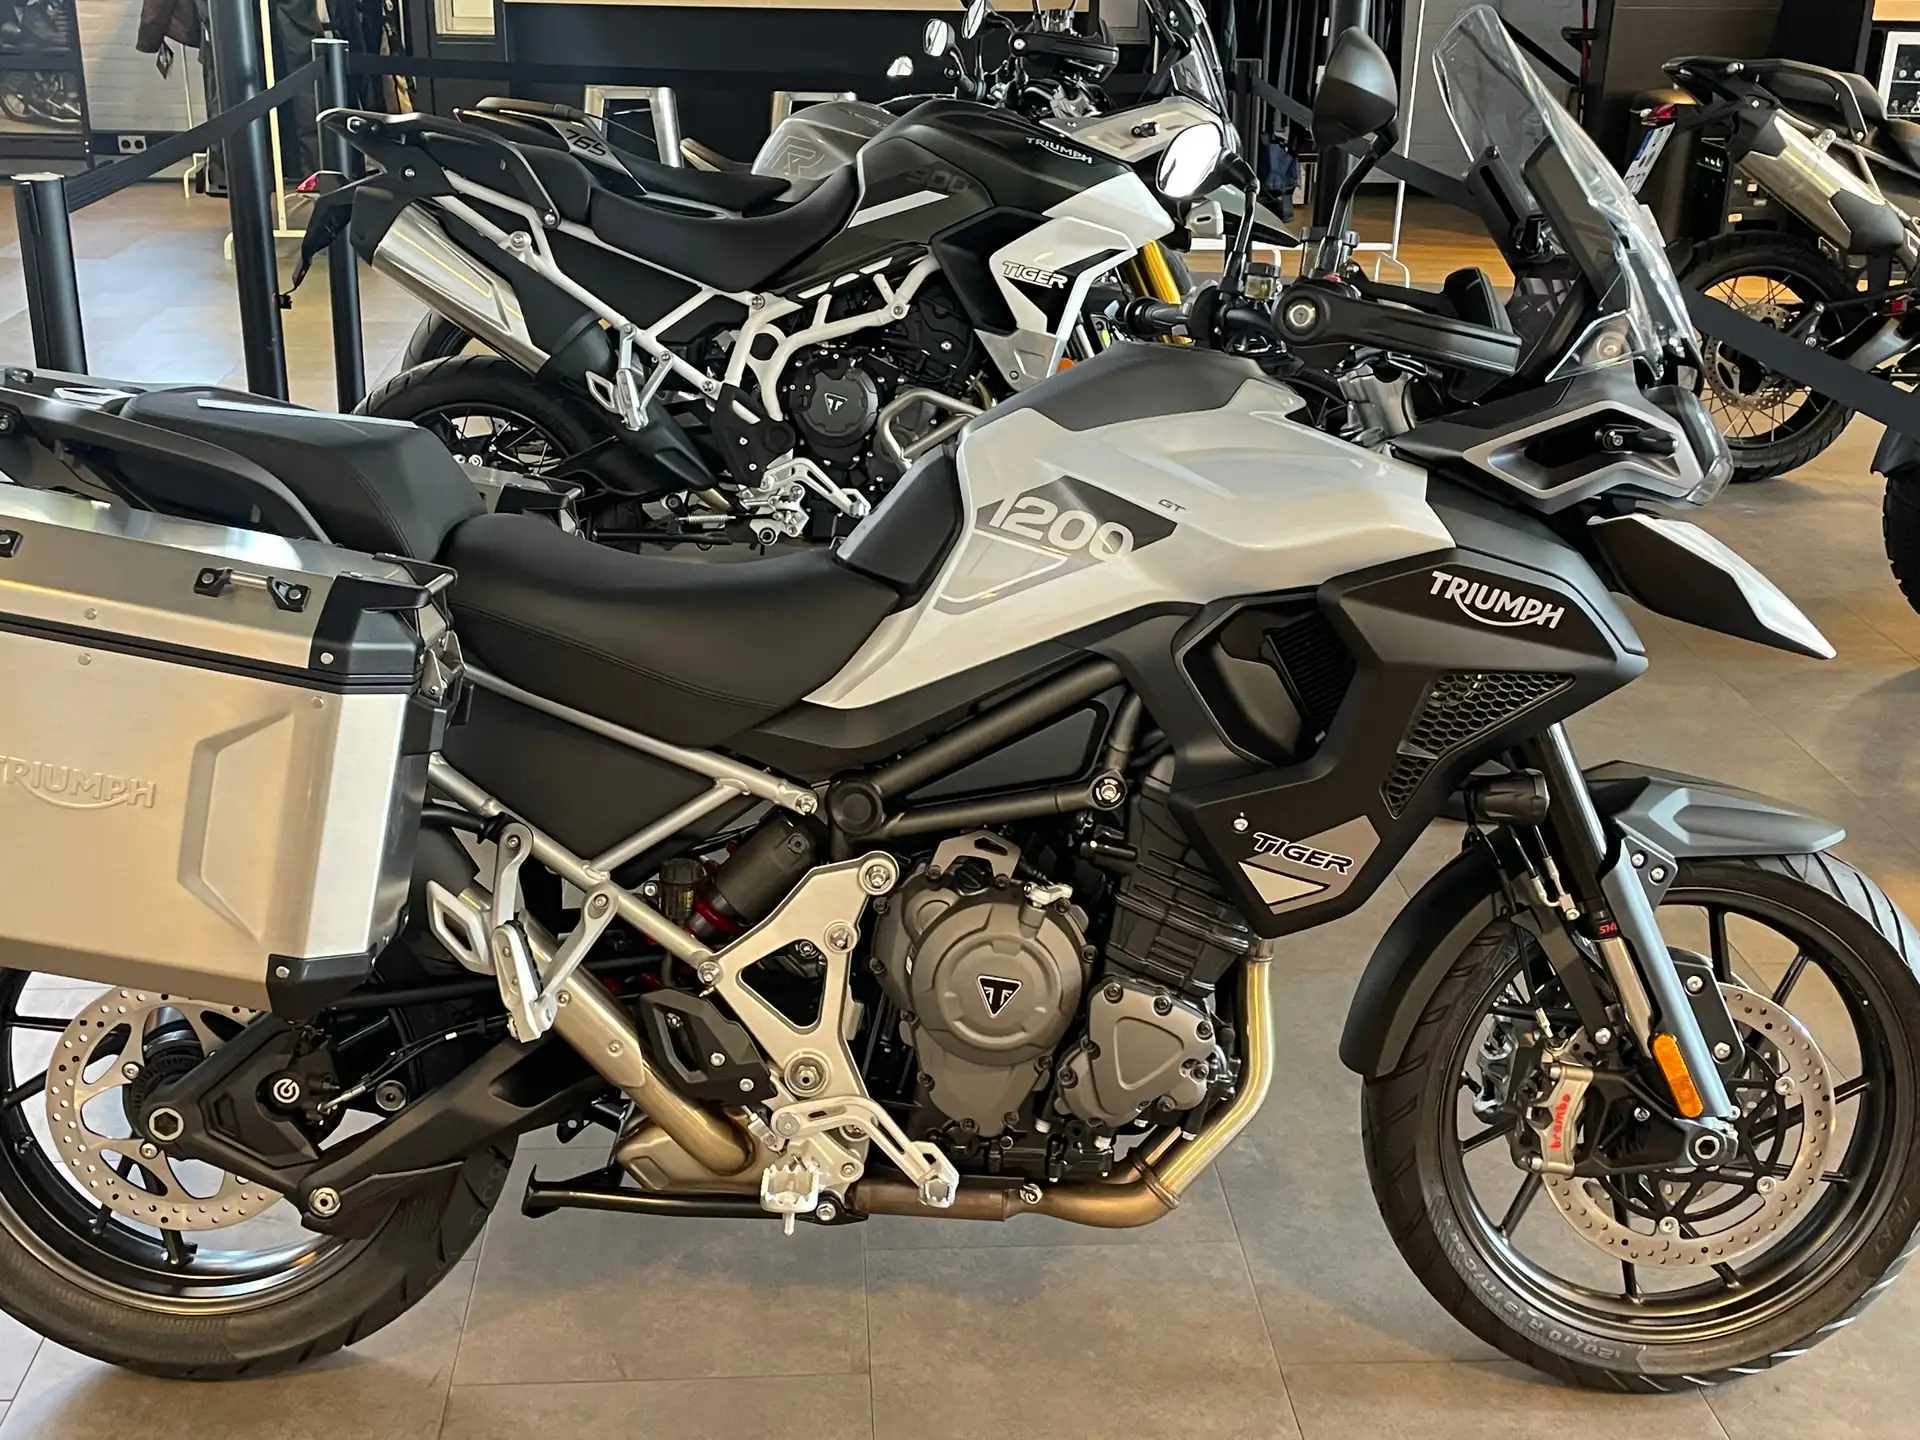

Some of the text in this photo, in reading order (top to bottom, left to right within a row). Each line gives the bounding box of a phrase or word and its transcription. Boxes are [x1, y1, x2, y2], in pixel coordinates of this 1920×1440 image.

[566, 128, 607, 156] 765
[1025, 137, 1093, 165] TRIUMPH
[1002, 260, 1068, 290] TIGER
[1157, 498, 1186, 513] GT
[988, 496, 1134, 562] 1200
[1429, 570, 1565, 629] TRIUMPH
[1252, 831, 1355, 876] TIGER
[1548, 1093, 1571, 1150] brembo
